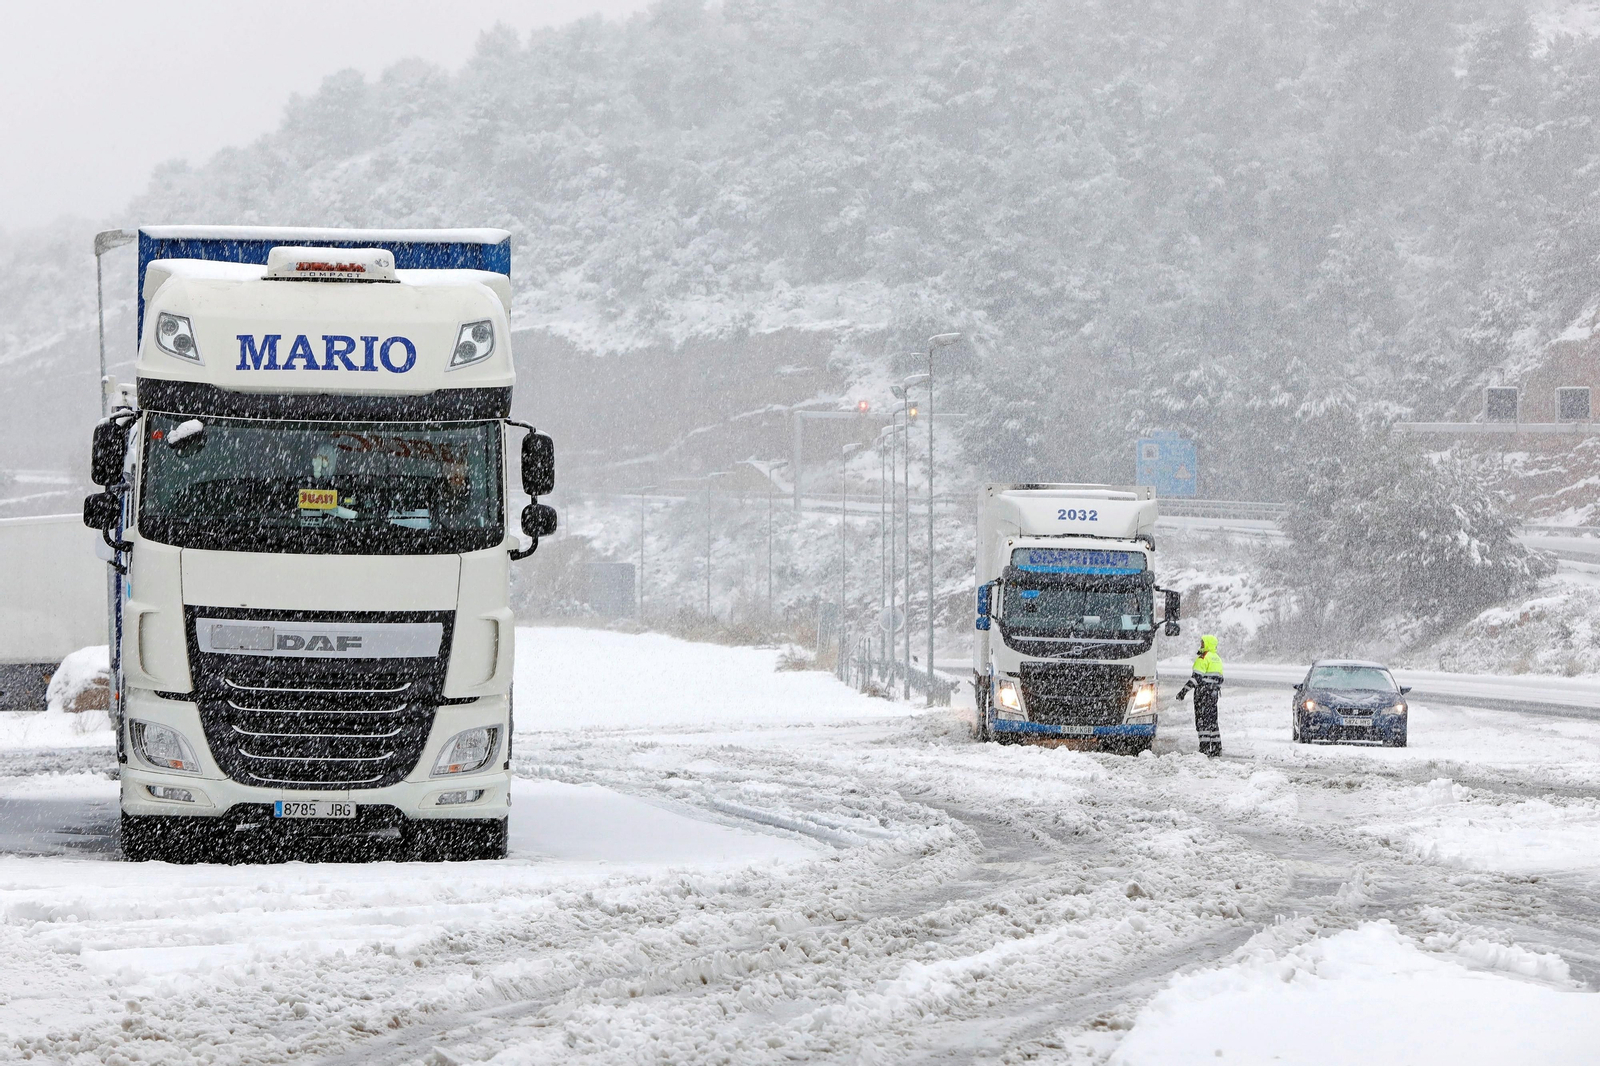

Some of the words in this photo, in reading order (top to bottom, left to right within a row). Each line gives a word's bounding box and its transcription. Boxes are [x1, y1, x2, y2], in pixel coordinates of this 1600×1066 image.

[235, 334, 417, 374] MARIO
[1057, 509, 1098, 521] 2032
[276, 634, 362, 651] DAF
[284, 803, 316, 816] 8785
[326, 803, 351, 817] JBG
